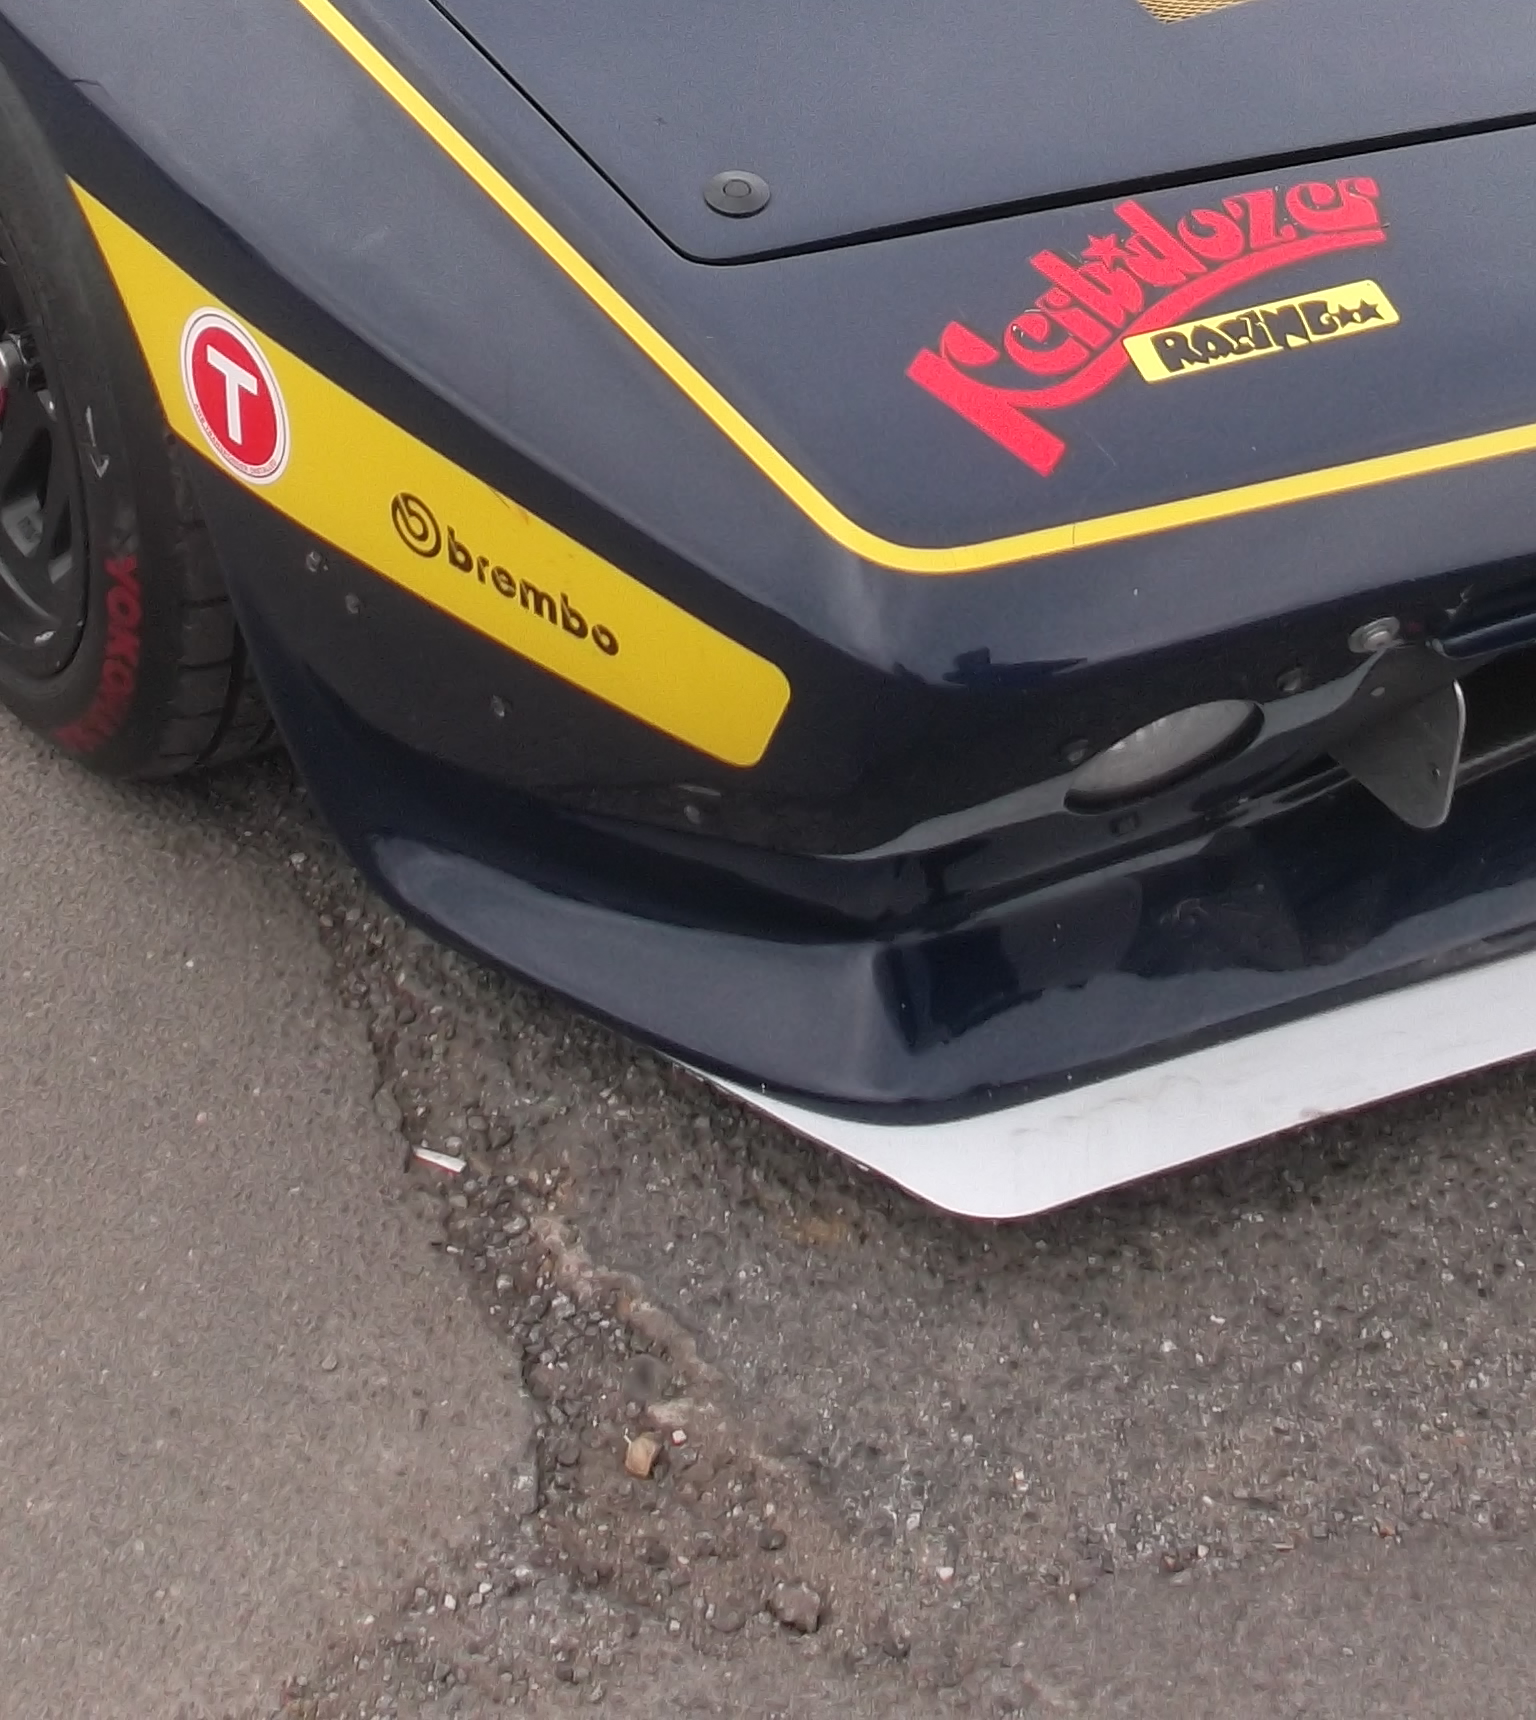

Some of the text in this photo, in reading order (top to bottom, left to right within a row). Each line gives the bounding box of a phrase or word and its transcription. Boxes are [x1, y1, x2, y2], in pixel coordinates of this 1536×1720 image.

[1150, 299, 1334, 373] RACING
[206, 343, 258, 446] T
[446, 525, 619, 657] brembo
